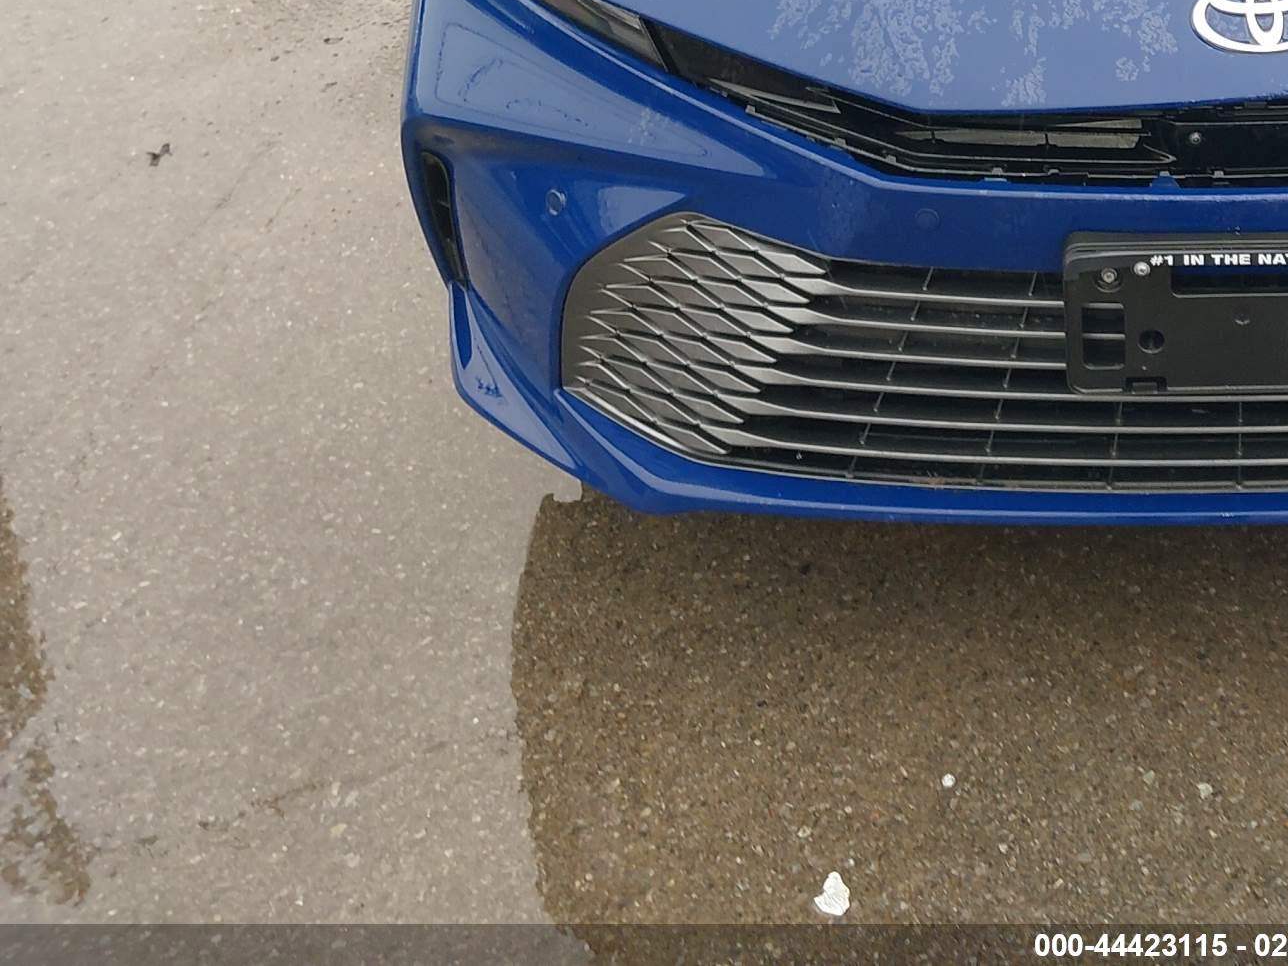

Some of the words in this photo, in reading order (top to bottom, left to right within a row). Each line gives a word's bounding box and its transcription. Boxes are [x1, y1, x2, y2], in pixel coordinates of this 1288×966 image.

[1150, 254, 1174, 267] #1
[1183, 254, 1205, 266] IN
[1211, 254, 1251, 266] THE
